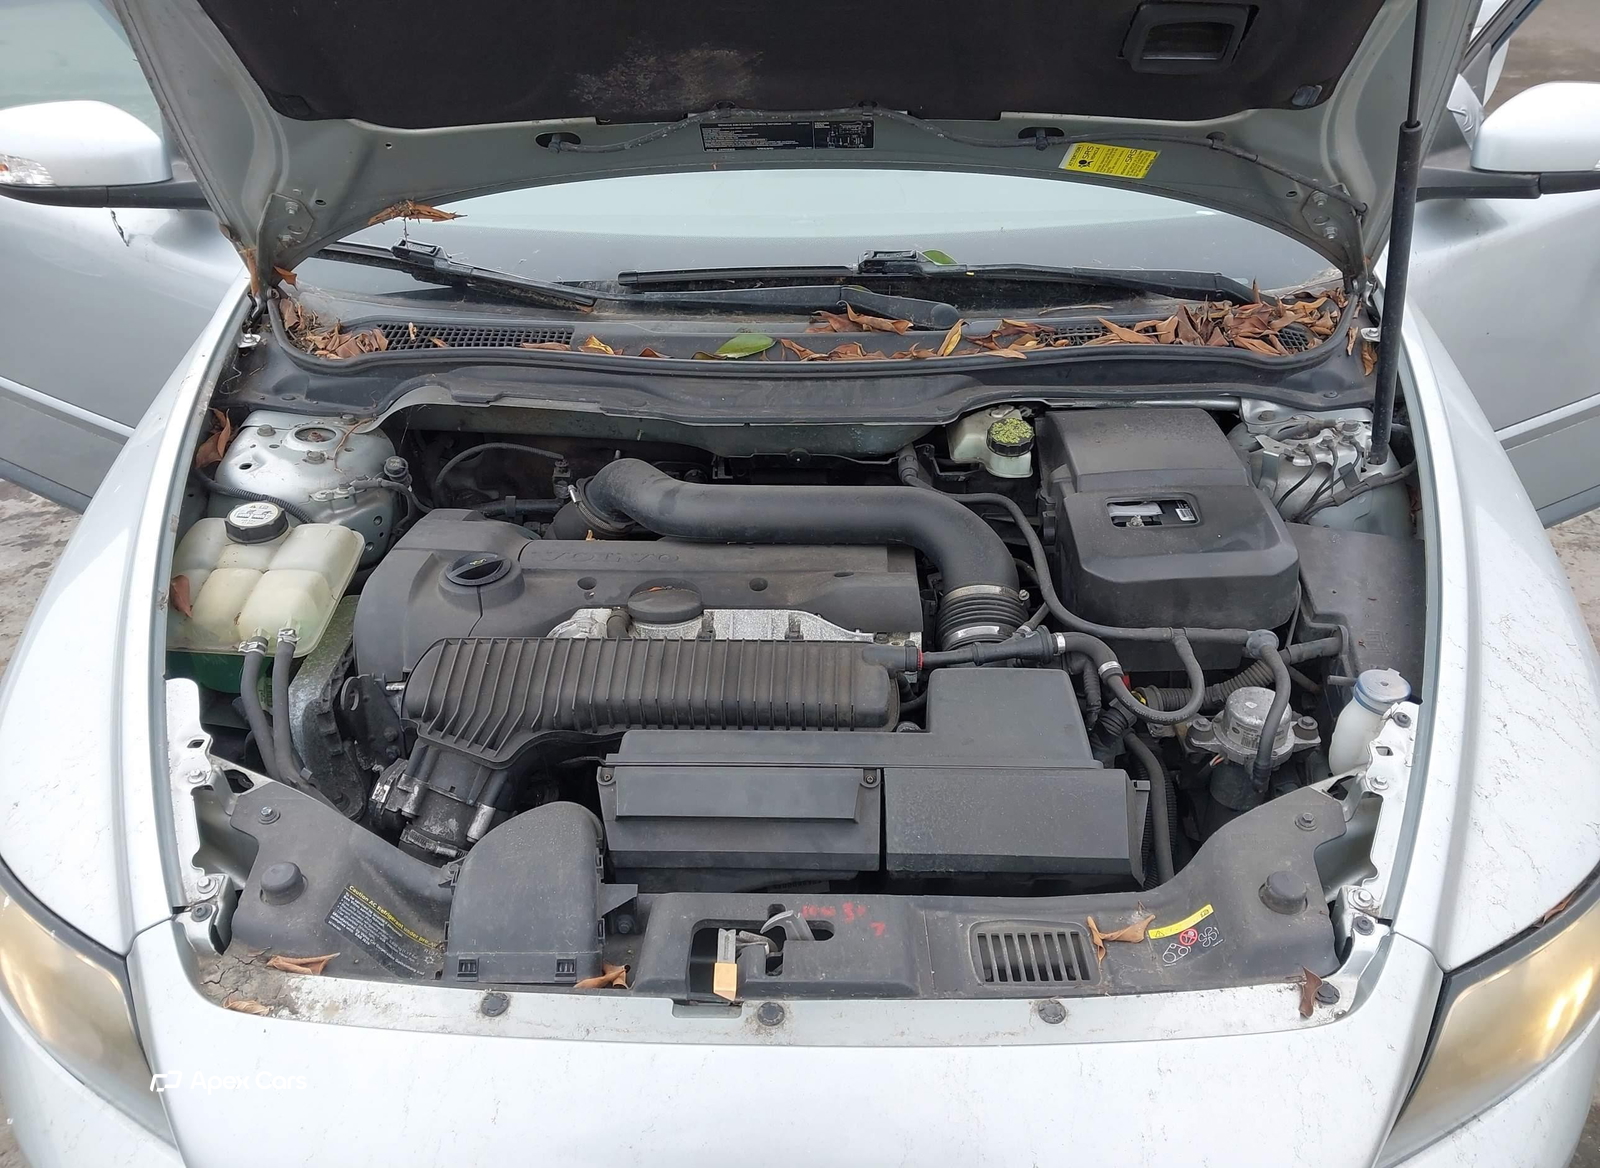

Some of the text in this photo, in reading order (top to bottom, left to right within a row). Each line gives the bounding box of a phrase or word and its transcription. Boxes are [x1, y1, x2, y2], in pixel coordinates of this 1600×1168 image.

[350, 885, 369, 901] Caution
[369, 900, 378, 908] AC
[377, 906, 404, 929] Refrigerant
[403, 927, 419, 939] under
